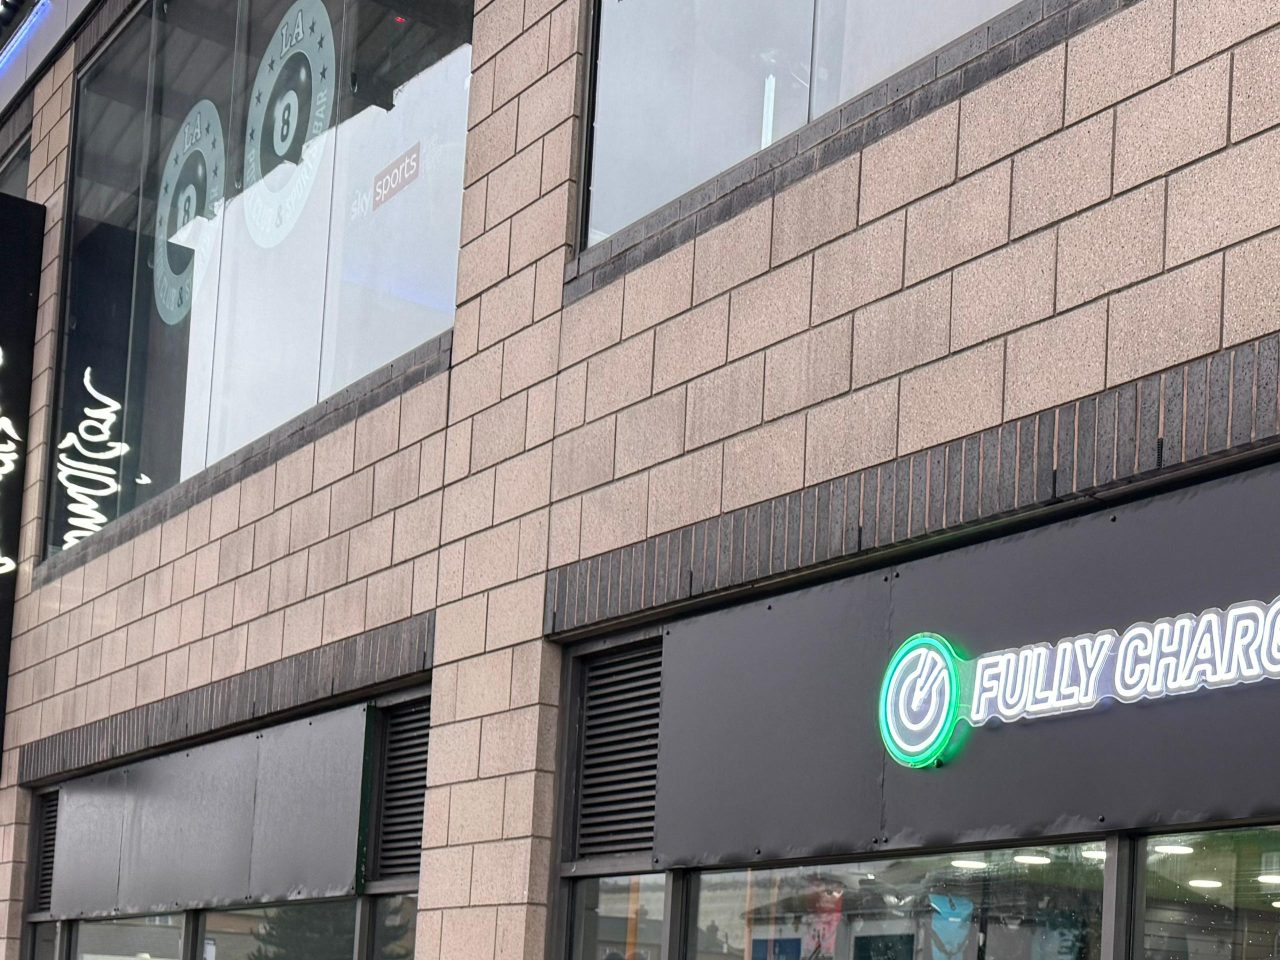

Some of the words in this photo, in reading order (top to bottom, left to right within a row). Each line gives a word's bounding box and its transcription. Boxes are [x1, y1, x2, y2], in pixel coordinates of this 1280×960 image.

[280, 10, 304, 57] LA
[183, 111, 202, 154] LA
[281, 102, 291, 143] 8
[375, 153, 418, 202] sports
[972, 635, 1113, 722] FULLY
